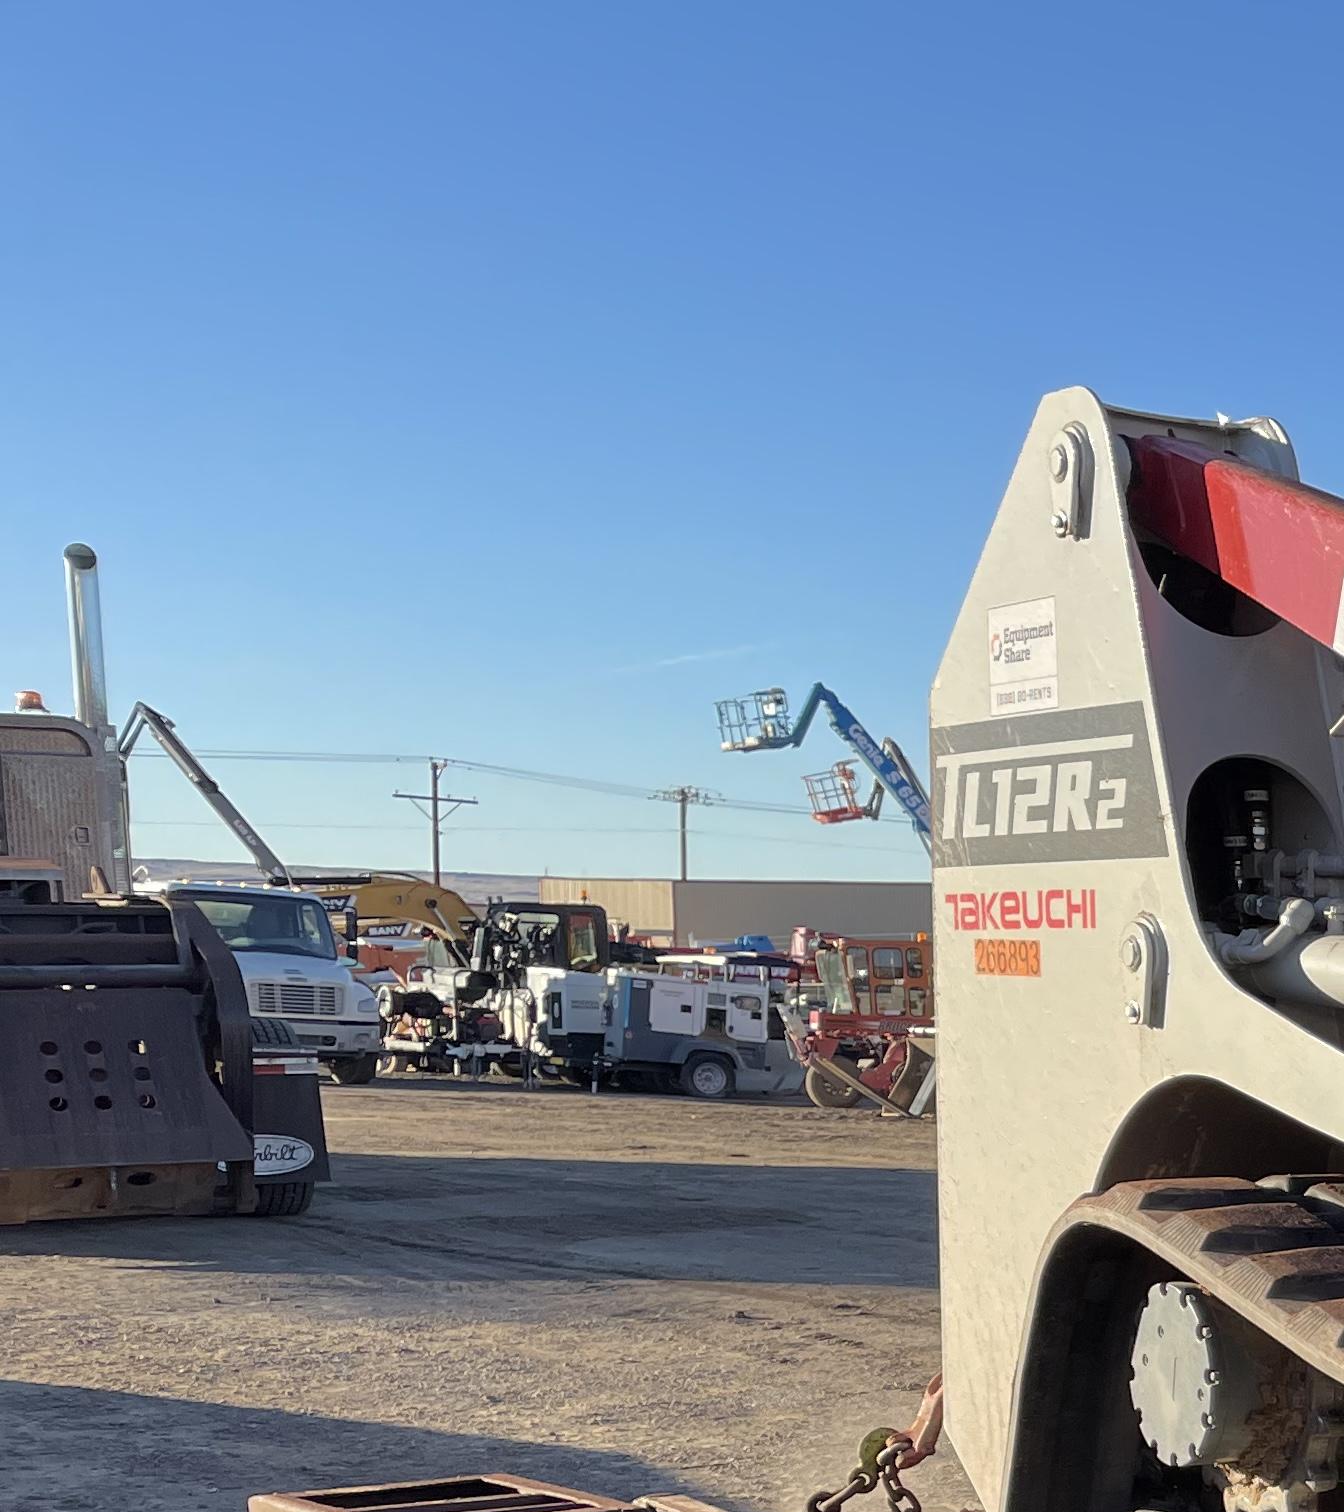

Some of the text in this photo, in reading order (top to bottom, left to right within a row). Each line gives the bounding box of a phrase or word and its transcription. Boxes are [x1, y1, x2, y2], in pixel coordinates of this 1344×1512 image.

[1003, 620, 1054, 646] Equipment
[1003, 647, 1031, 664] Share
[849, 723, 885, 769] Genie
[368, 925, 403, 937] SANY
[975, 939, 1040, 975] 266893
